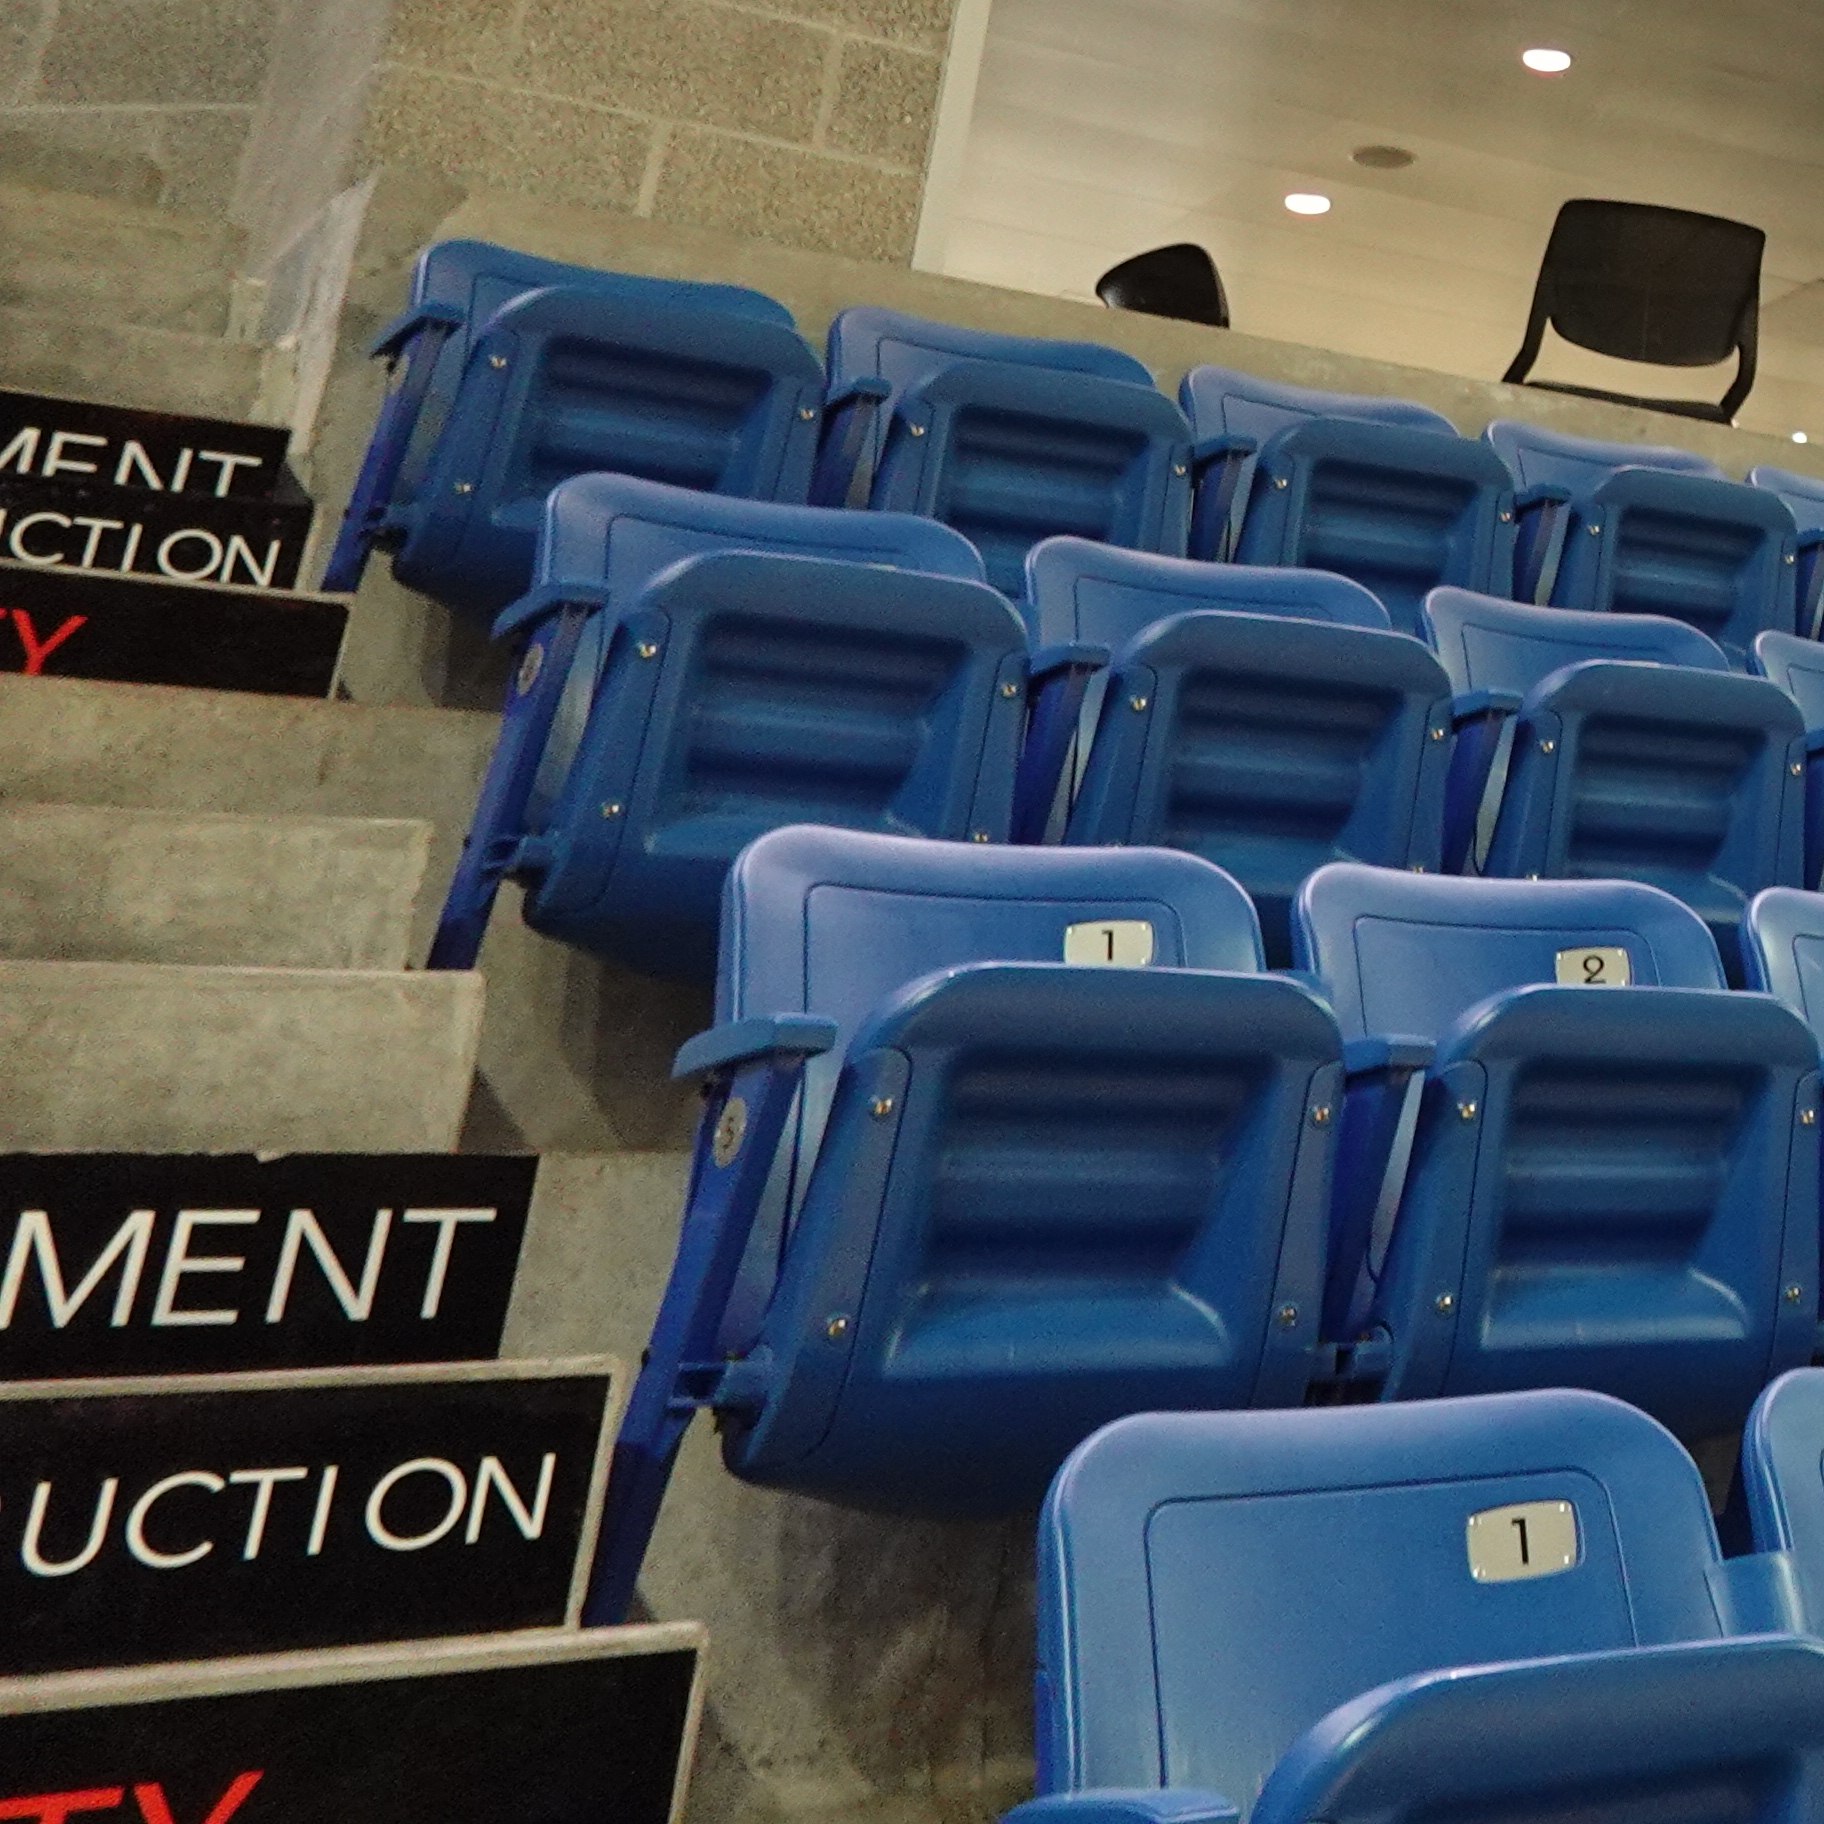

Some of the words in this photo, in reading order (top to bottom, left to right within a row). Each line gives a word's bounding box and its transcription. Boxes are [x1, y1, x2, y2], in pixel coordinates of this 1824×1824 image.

[0, 509, 282, 587] CTION
[1102, 929, 1114, 962] 1
[1582, 955, 1606, 984] 2
[0, 1208, 498, 1331] MENT
[1511, 1517, 1529, 1565] 1
